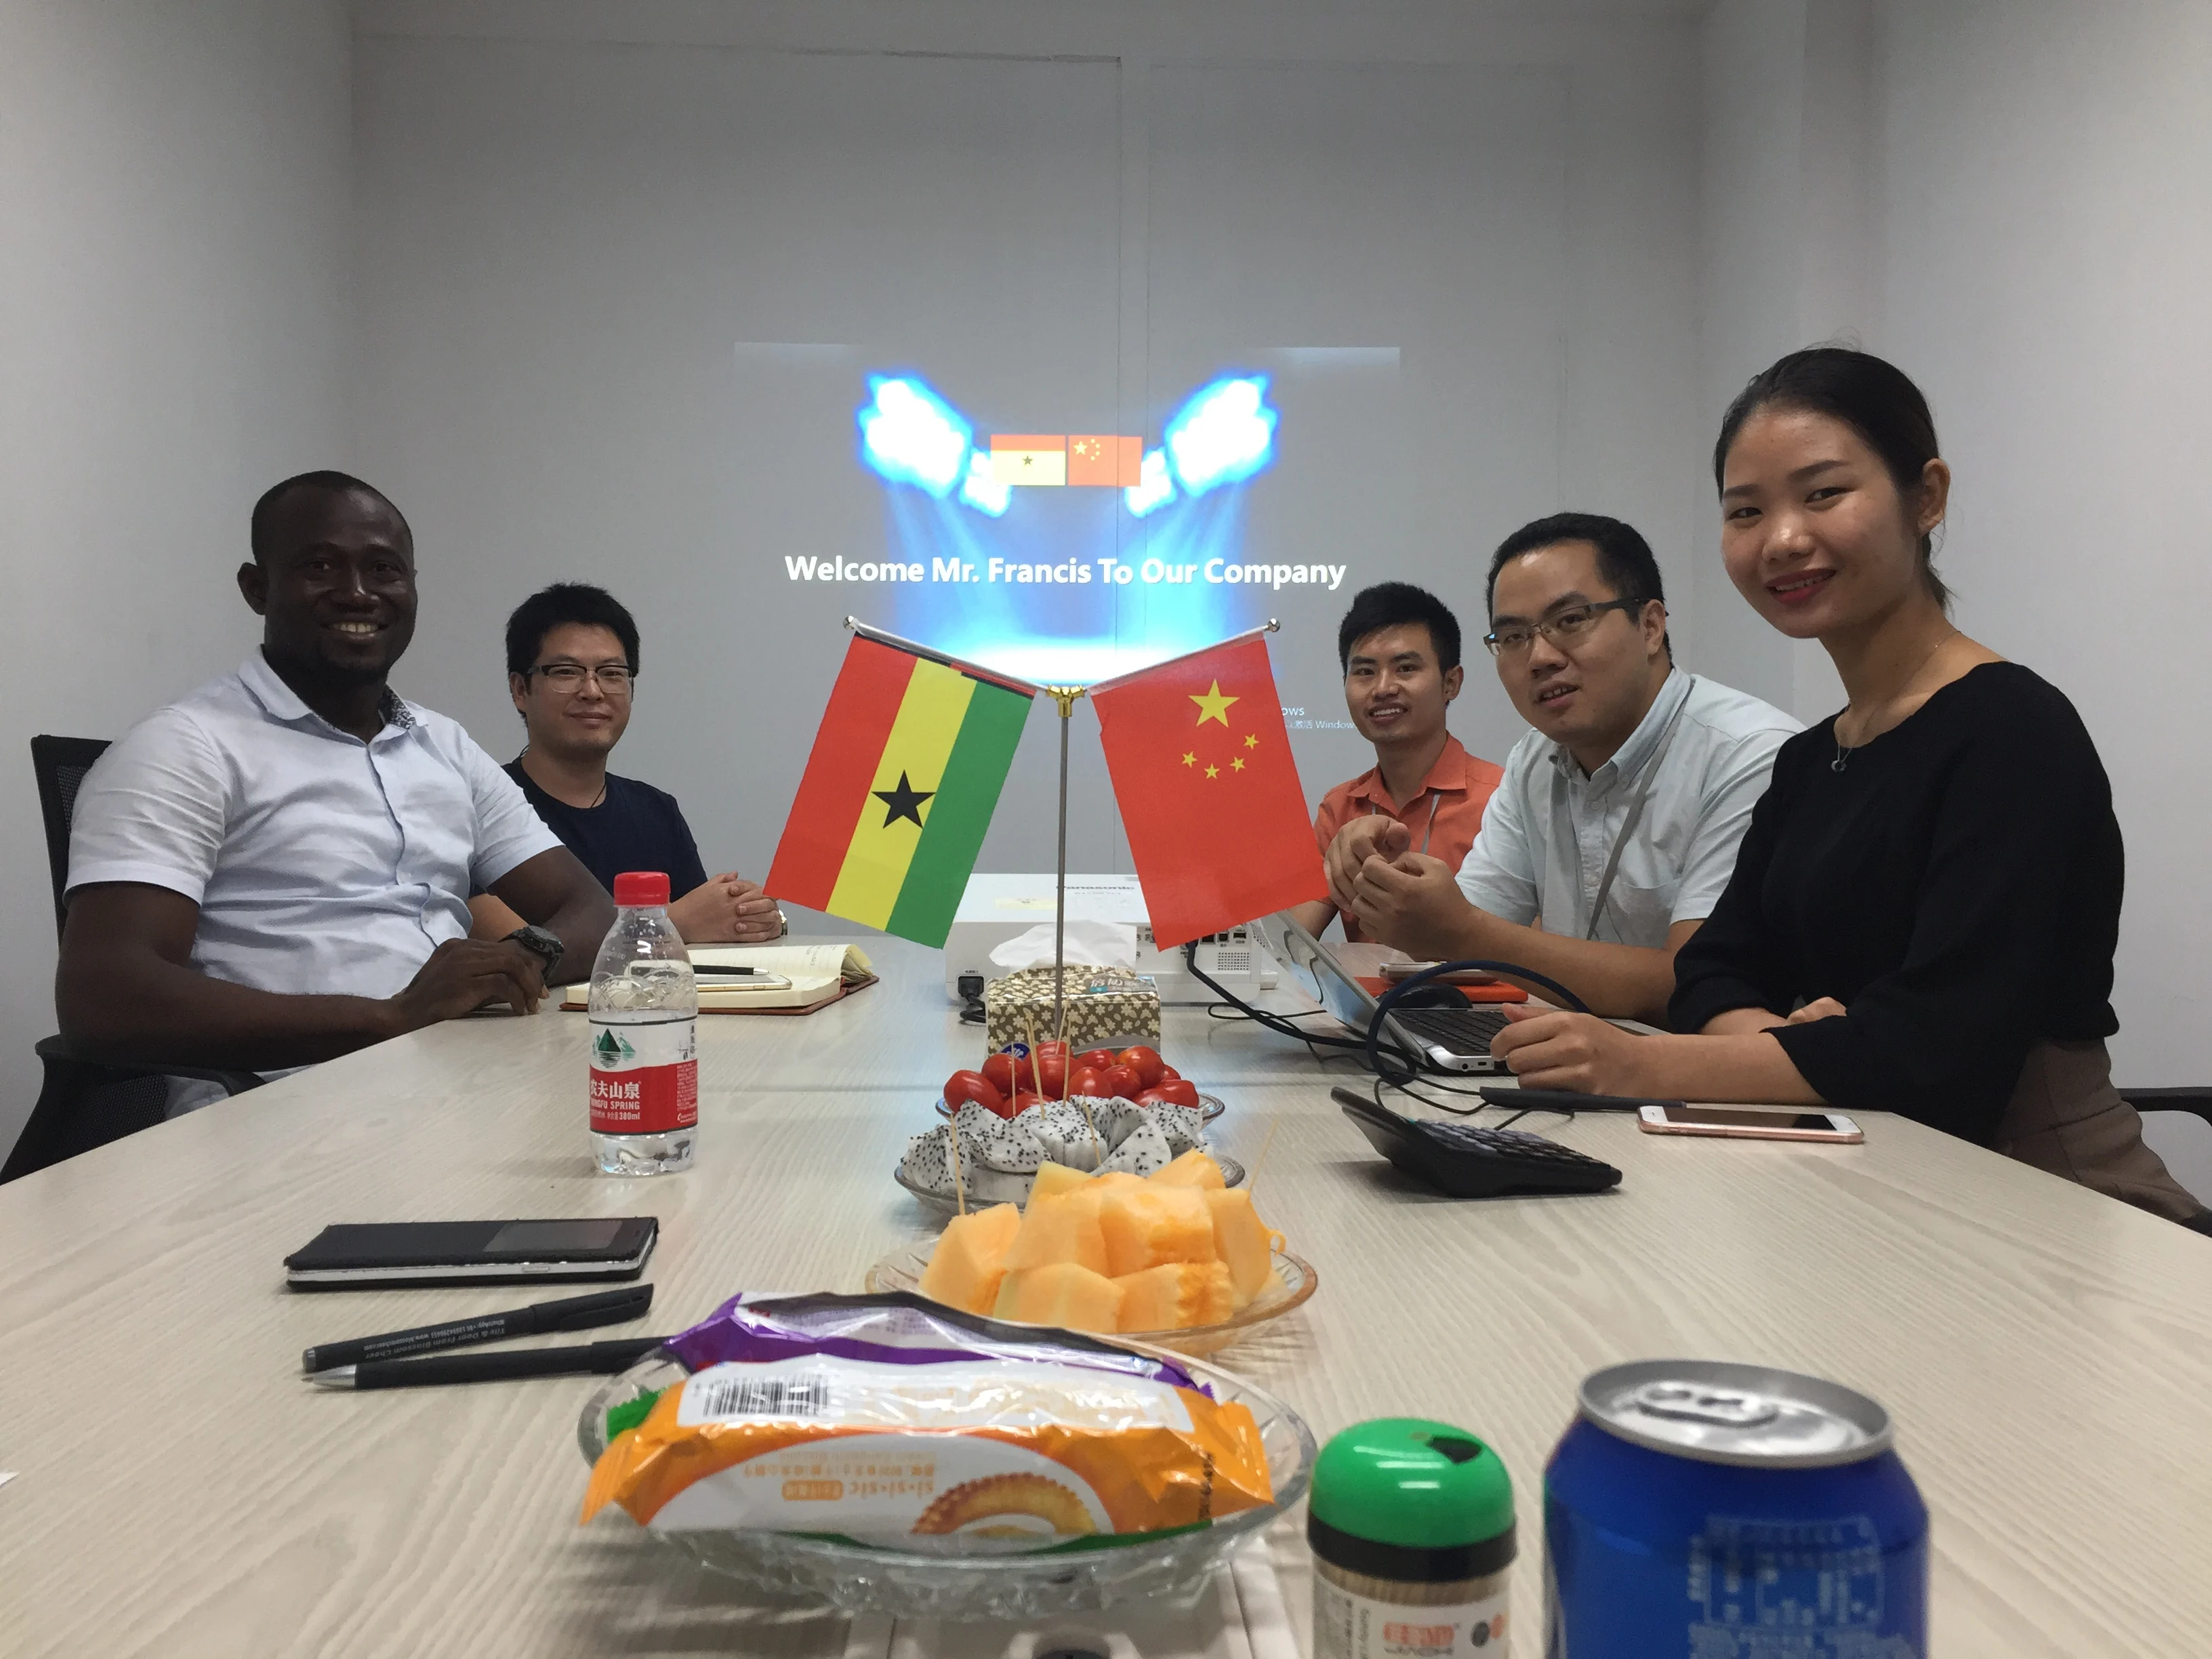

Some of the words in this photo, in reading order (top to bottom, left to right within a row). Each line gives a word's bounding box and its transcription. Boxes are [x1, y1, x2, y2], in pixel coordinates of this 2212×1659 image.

[785, 556, 924, 582] Welcome
[932, 557, 979, 583] Mr.
[988, 557, 1092, 583] Francis
[1097, 558, 1134, 585] To
[1141, 558, 1197, 584] Our
[1204, 558, 1347, 590] Company
[1282, 708, 1305, 716] ows
[1315, 720, 1355, 729] Window
[610, 1101, 640, 1109] SPRING
